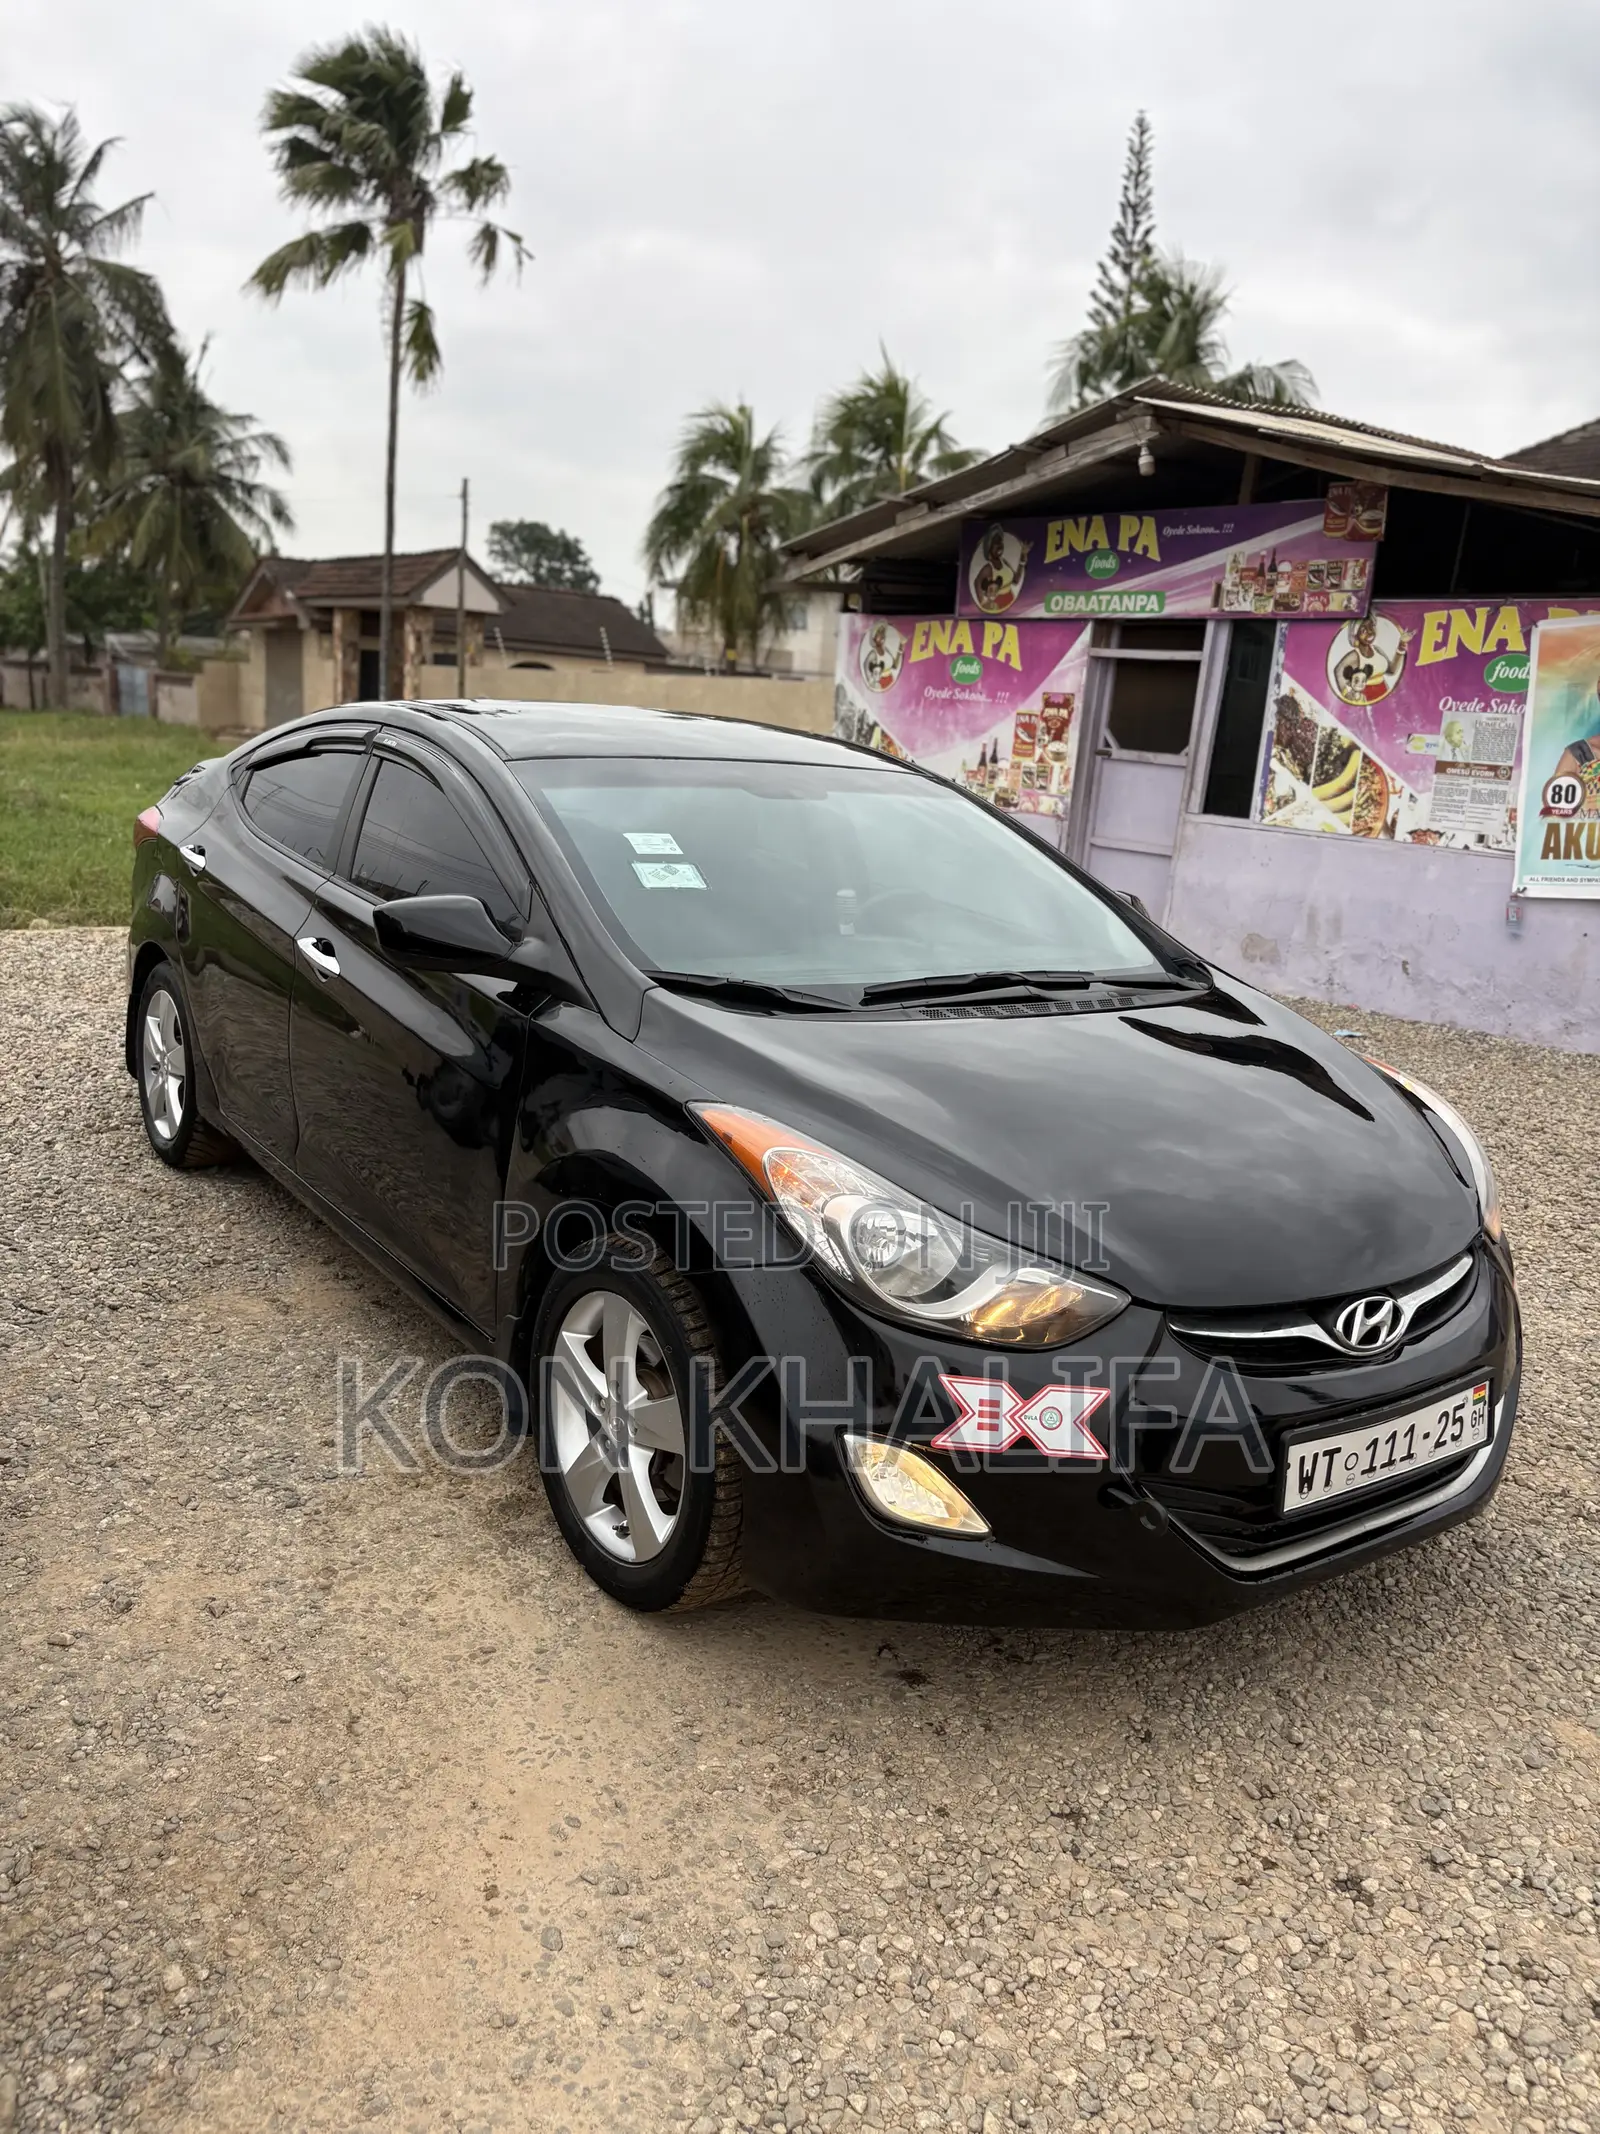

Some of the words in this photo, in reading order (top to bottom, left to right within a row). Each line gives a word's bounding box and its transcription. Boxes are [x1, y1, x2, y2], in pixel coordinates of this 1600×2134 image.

[1044, 515, 1110, 564] ENA
[1117, 515, 1161, 562] PA
[1089, 555, 1116, 572] foods
[1050, 594, 1160, 612] OBAATANPA
[909, 619, 974, 663] ENA
[982, 620, 1022, 671] PA
[1415, 605, 1527, 667] ENA
[954, 661, 981, 677] foods
[1488, 661, 1531, 683] food
[1551, 784, 1577, 805] 80
[1541, 823, 1600, 861] AKU
[1470, 1407, 1485, 1429] GH
[1298, 1447, 1342, 1494] WT
